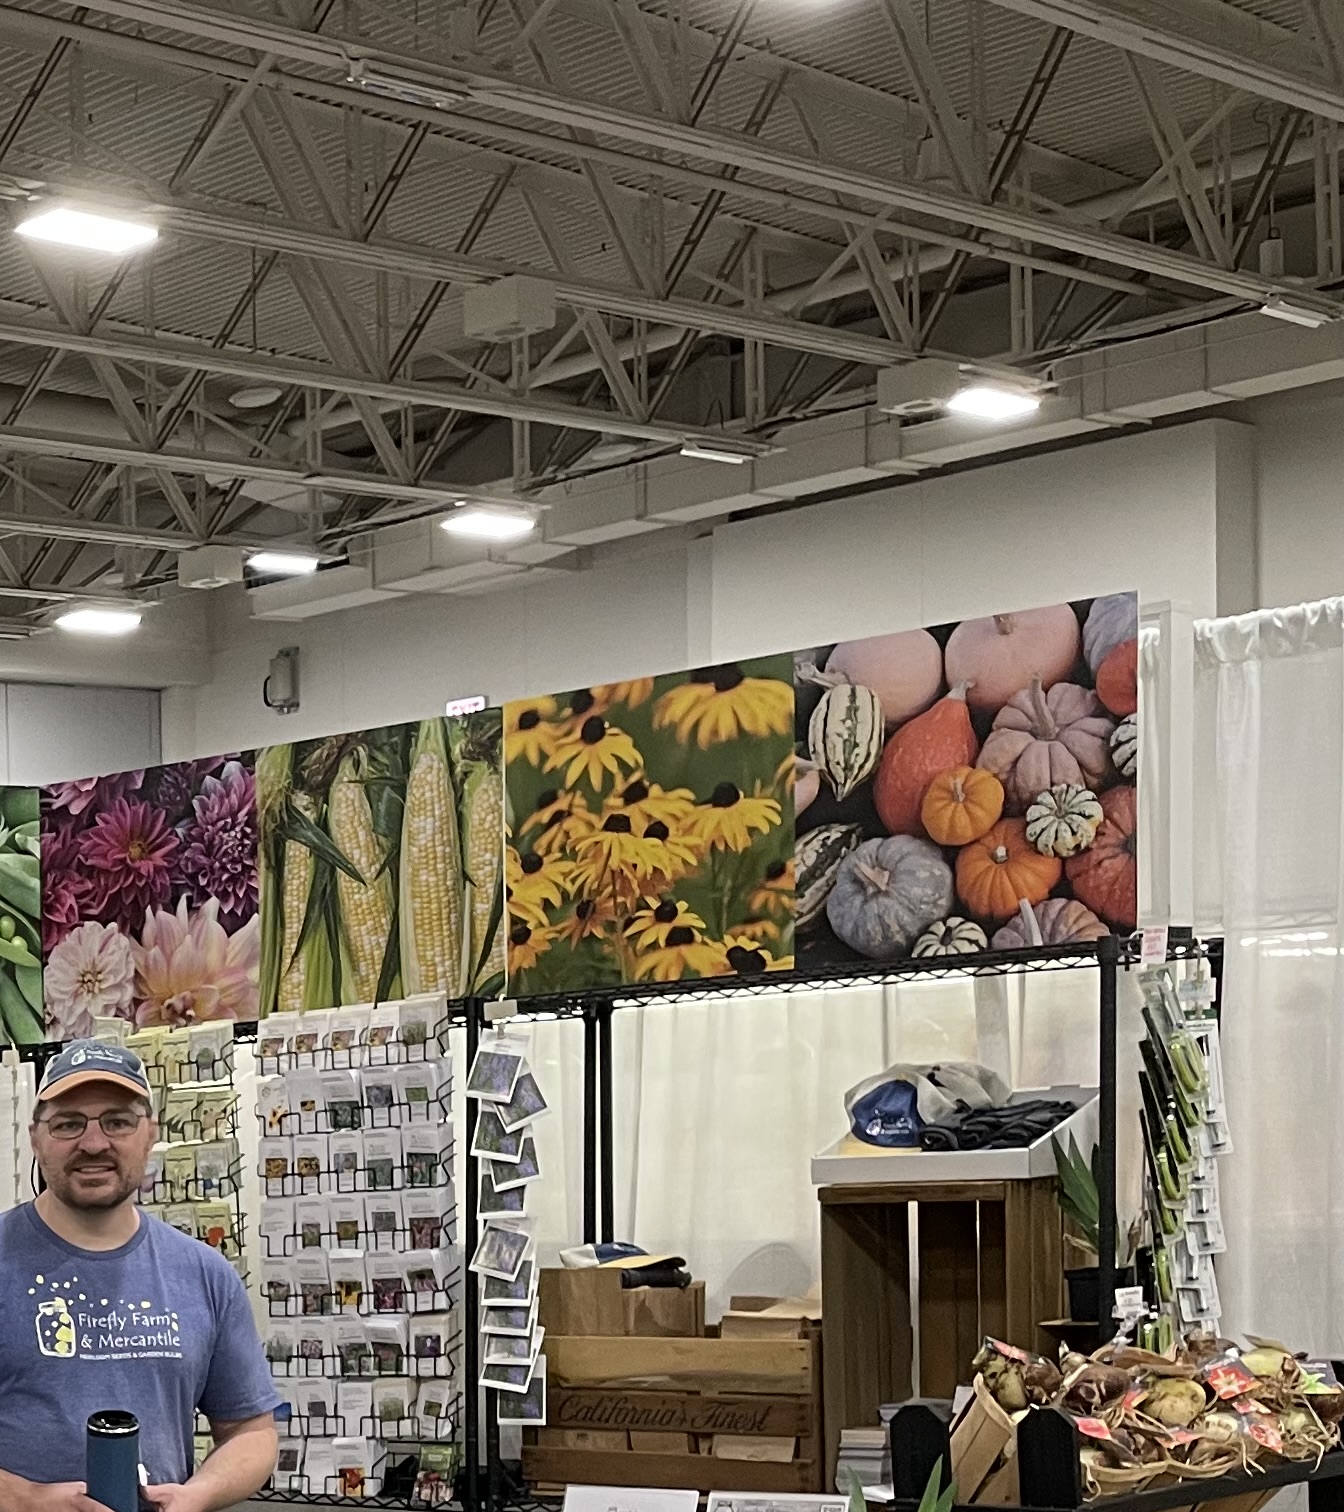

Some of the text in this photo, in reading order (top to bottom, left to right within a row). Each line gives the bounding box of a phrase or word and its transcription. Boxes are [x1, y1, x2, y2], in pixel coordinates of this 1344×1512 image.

[78, 1310, 170, 1331] Firefly Farm
[80, 1329, 181, 1350] & Mercantile
